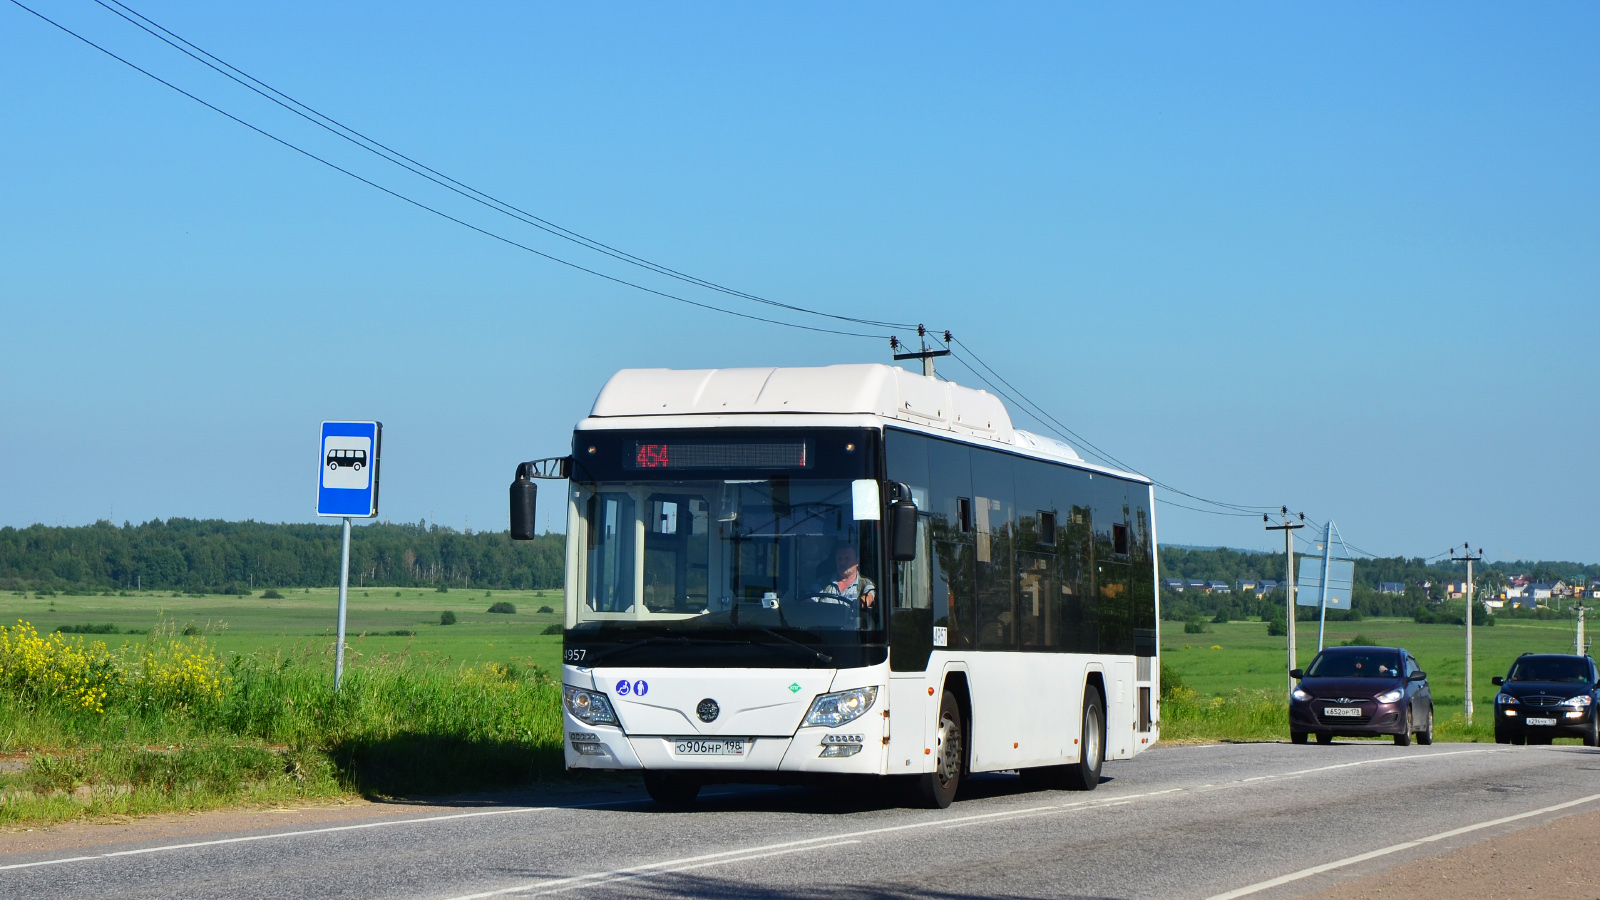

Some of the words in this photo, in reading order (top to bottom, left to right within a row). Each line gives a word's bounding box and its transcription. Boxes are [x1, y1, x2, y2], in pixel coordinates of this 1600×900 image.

[637, 444, 669, 468] 454
[563, 649, 586, 661] 4957
[724, 741, 741, 751] 198
